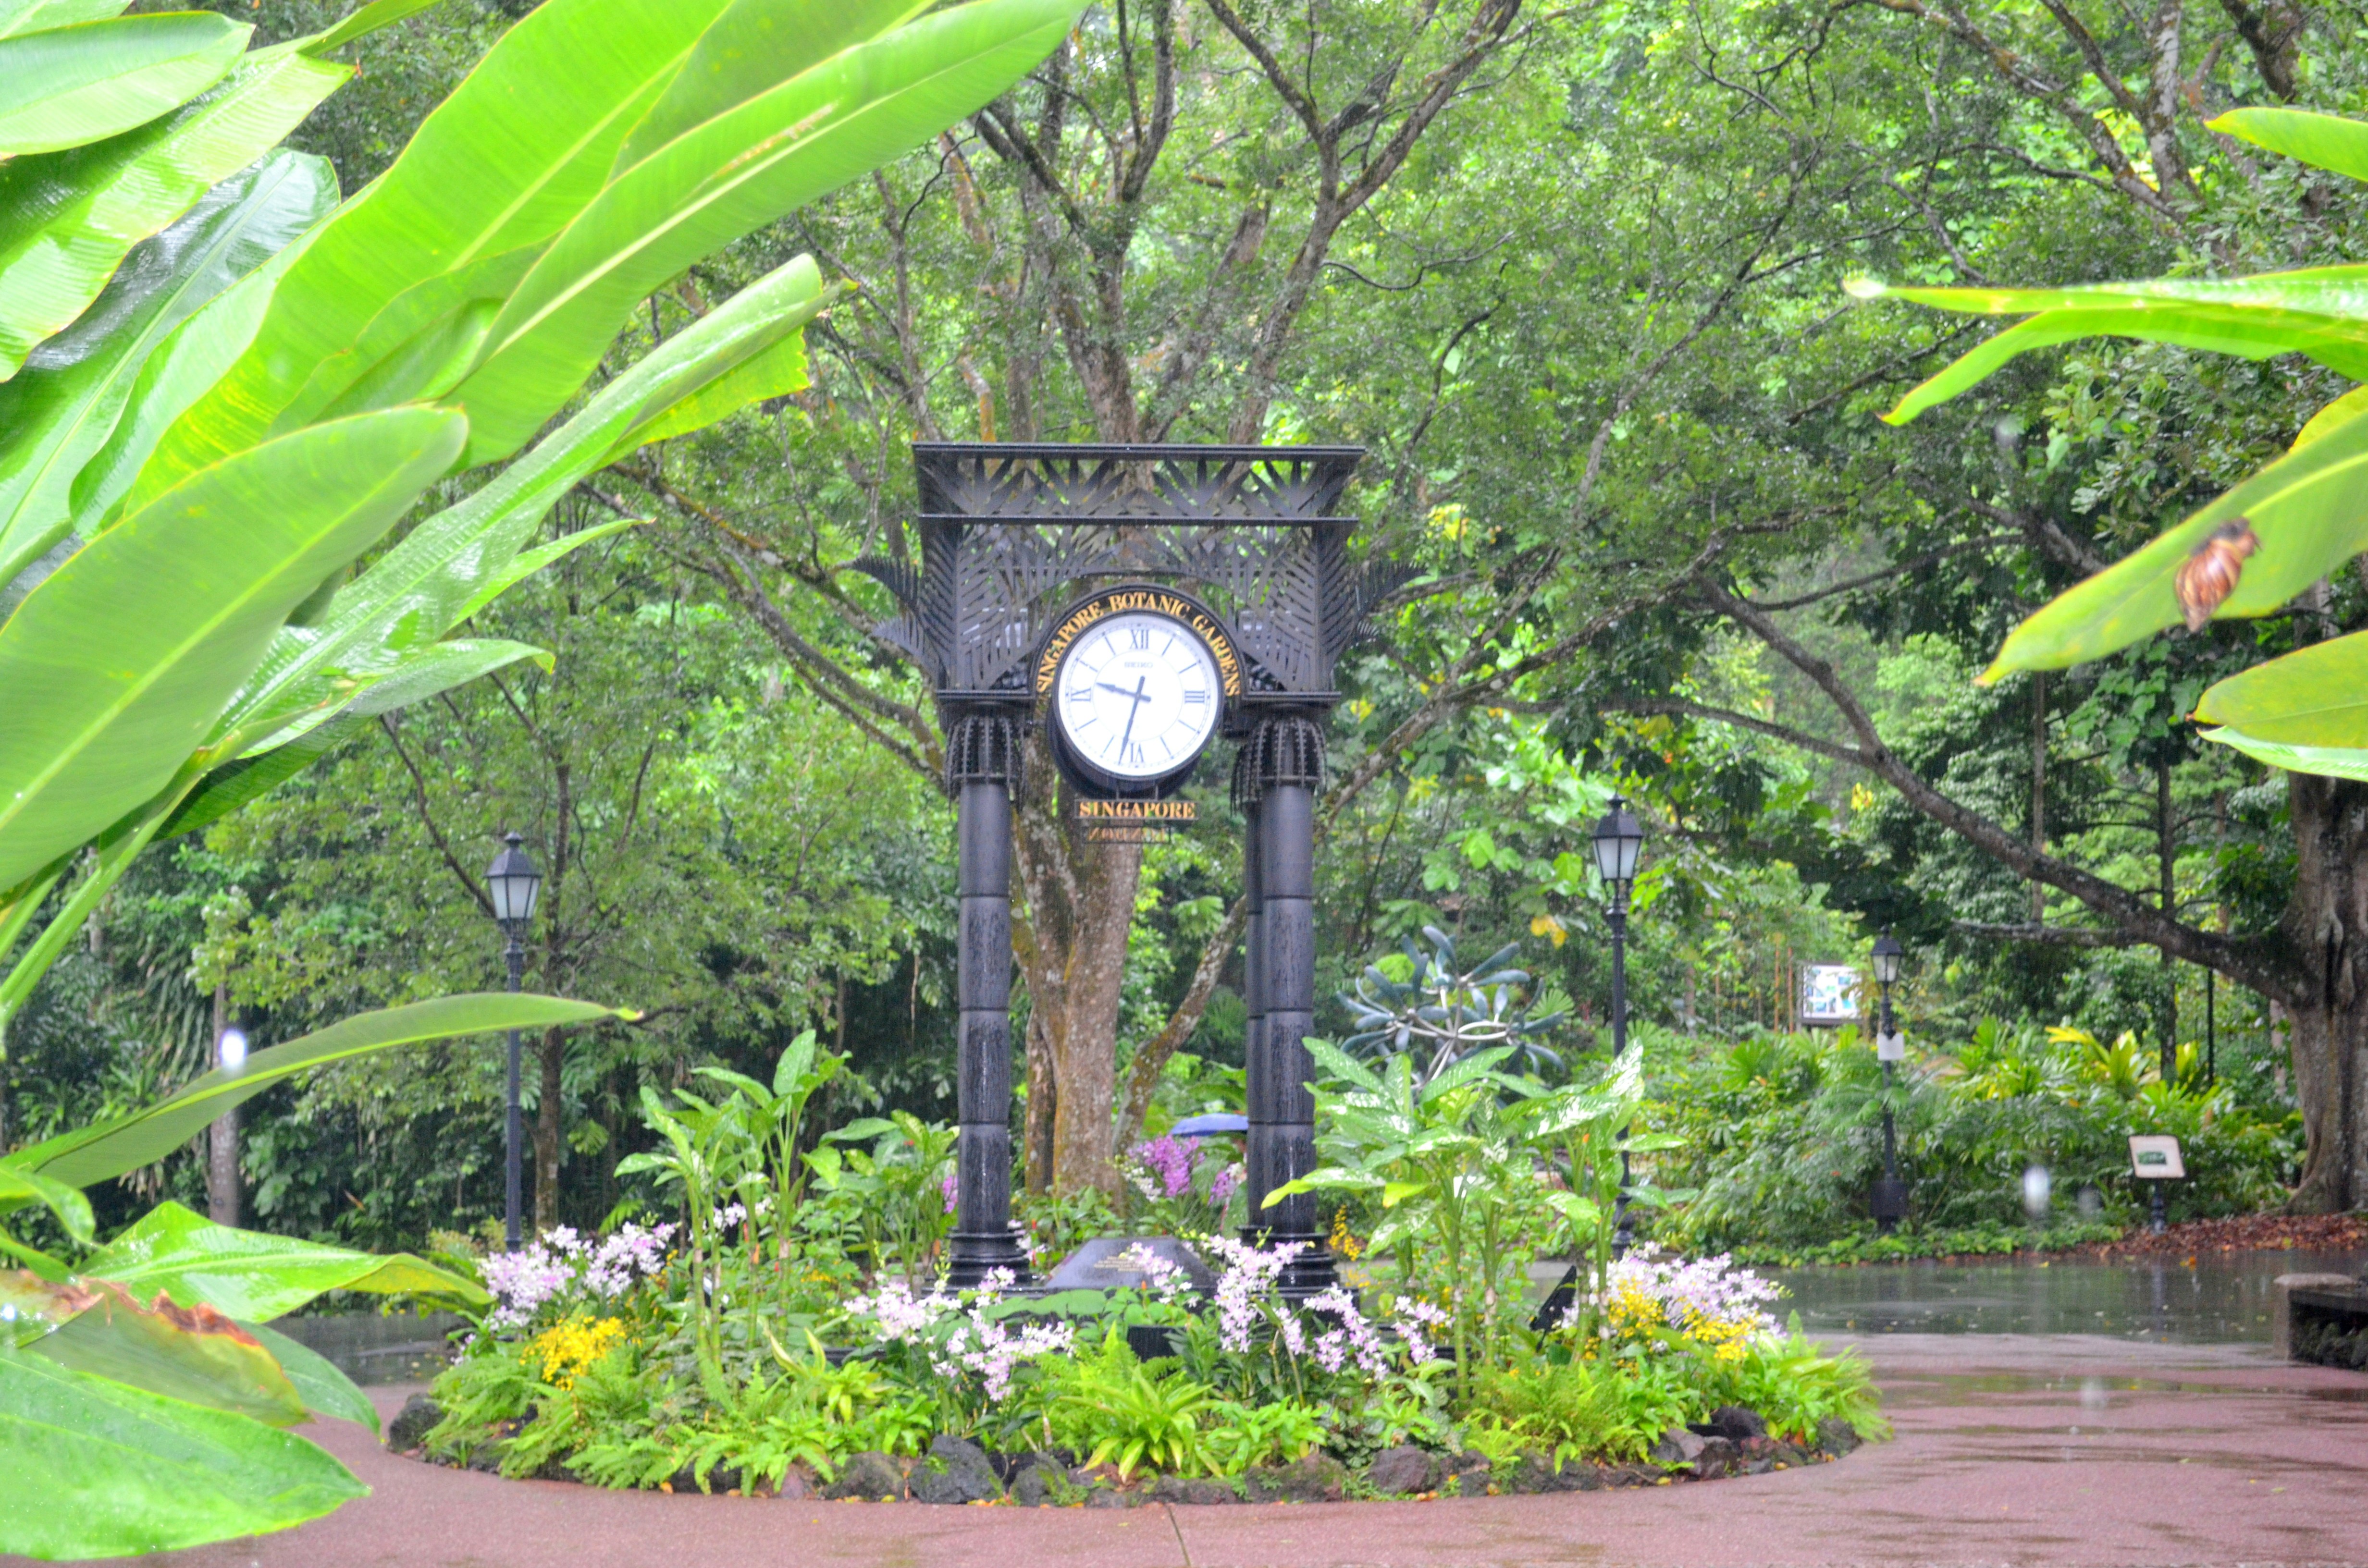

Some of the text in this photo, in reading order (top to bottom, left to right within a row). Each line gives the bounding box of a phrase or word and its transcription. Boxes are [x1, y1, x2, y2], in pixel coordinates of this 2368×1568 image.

[1036, 592, 1240, 697] SINGAPORE BOTANIC GARDENS
[1129, 629, 1149, 649] XII
[1184, 690, 1205, 703] III
[1080, 801, 1195, 819] SINGAPORE
